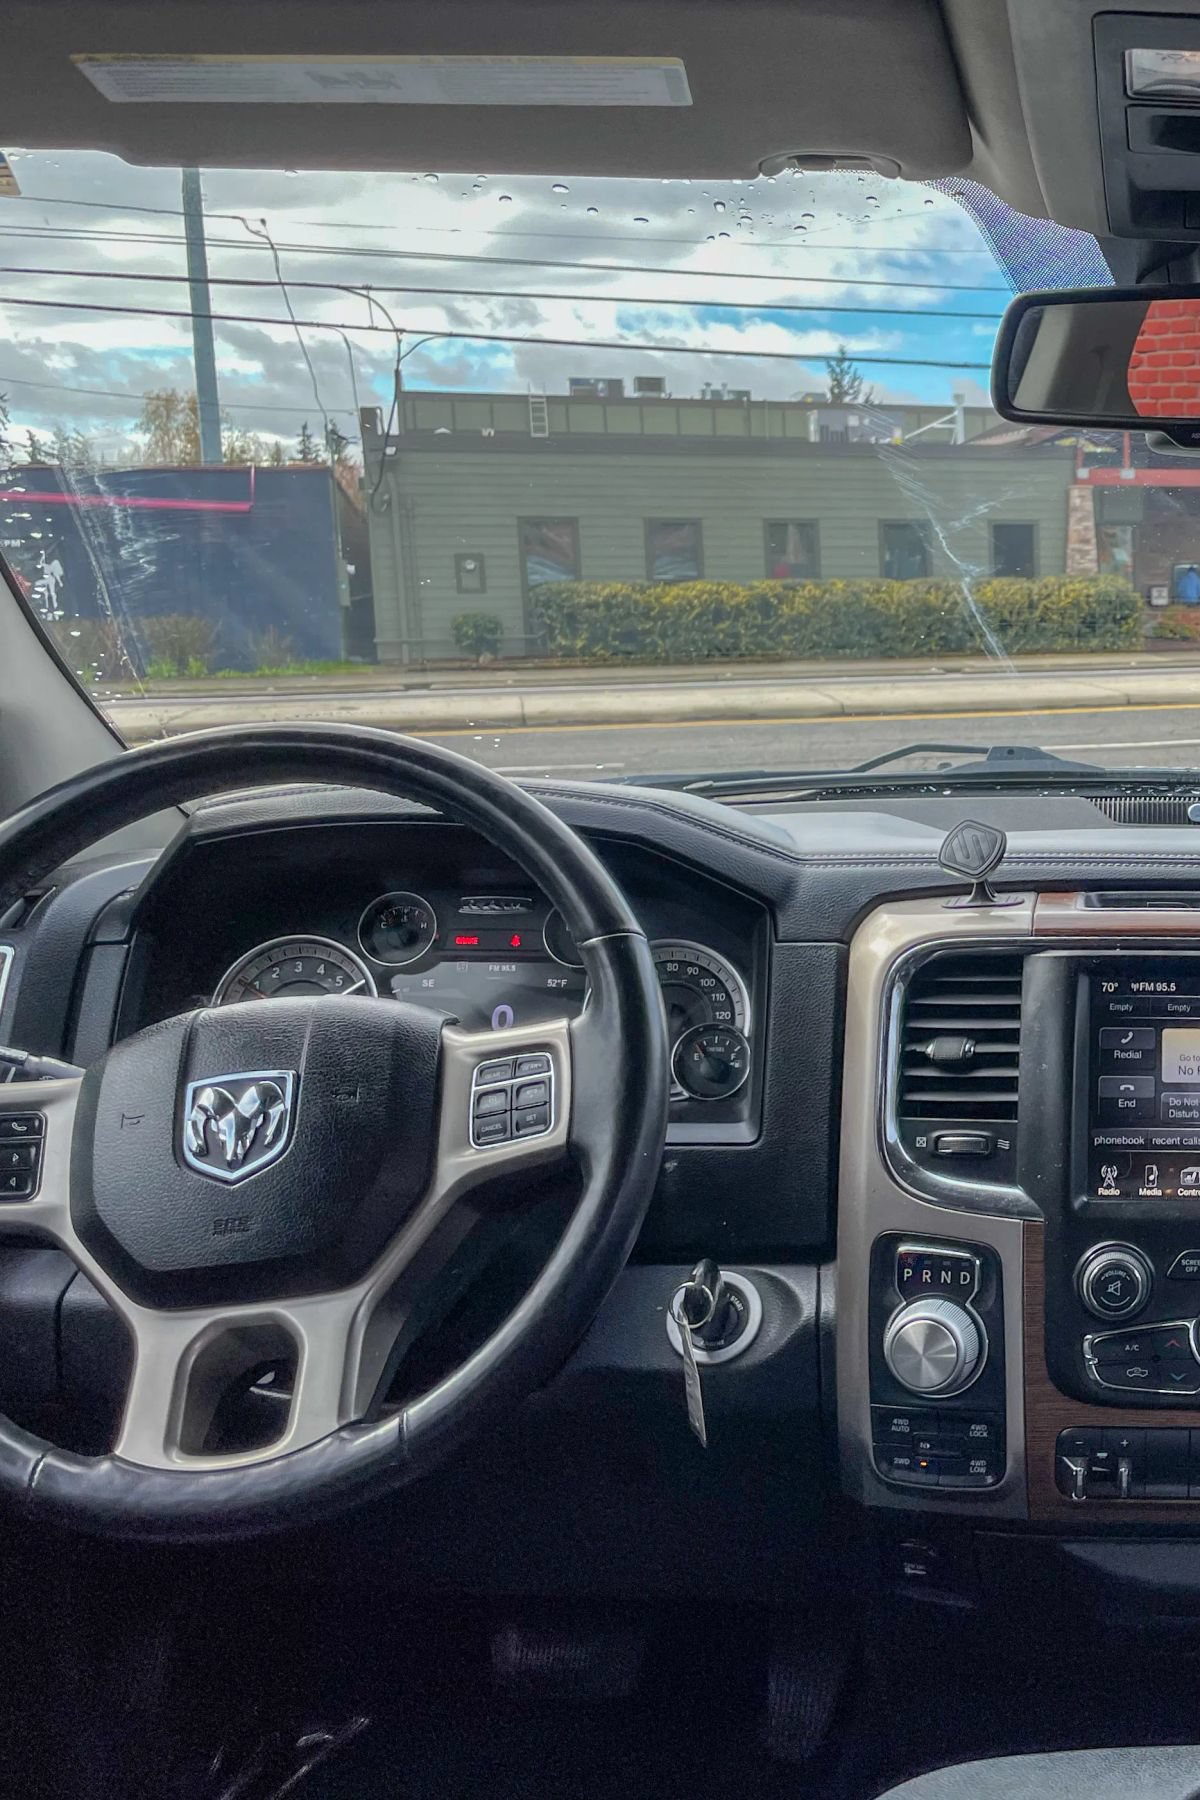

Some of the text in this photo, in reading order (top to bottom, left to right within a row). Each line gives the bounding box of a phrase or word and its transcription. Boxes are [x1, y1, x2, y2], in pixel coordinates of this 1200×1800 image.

[294, 961, 303, 973] 3
[316, 964, 325, 975] 4
[666, 963, 679, 972] 80
[686, 966, 699, 976] 90
[271, 967, 280, 979] 2
[335, 975, 343, 987] 5
[422, 979, 435, 988] SE
[700, 978, 716, 987] 100
[1101, 982, 1119, 992] 70°
[1139, 982, 1154, 992] FM
[1156, 982, 1176, 992] 95.5
[711, 993, 726, 1001] 110
[1109, 1003, 1133, 1012] Empty
[1167, 1003, 1191, 1012] Empty
[491, 1004, 514, 1032] 0
[715, 1011, 731, 1020] 120
[693, 1053, 700, 1061] E
[1114, 1050, 1142, 1059] Redial
[1179, 1054, 1190, 1062] Go
[1193, 1054, 1200, 1062] to
[1178, 1066, 1193, 1076] No
[1118, 1099, 1136, 1108] End
[1169, 1098, 1199, 1106] Do Not
[1169, 1109, 1199, 1118] Disturb
[481, 1123, 503, 1132] CANCEL
[1094, 1136, 1145, 1146] phonebook
[1152, 1137, 1181, 1145] recent
[1097, 1188, 1120, 1196] Radio
[1139, 1188, 1162, 1197] Media
[904, 1268, 970, 1284] P R N D
[1105, 1270, 1127, 1278] VOLUME
